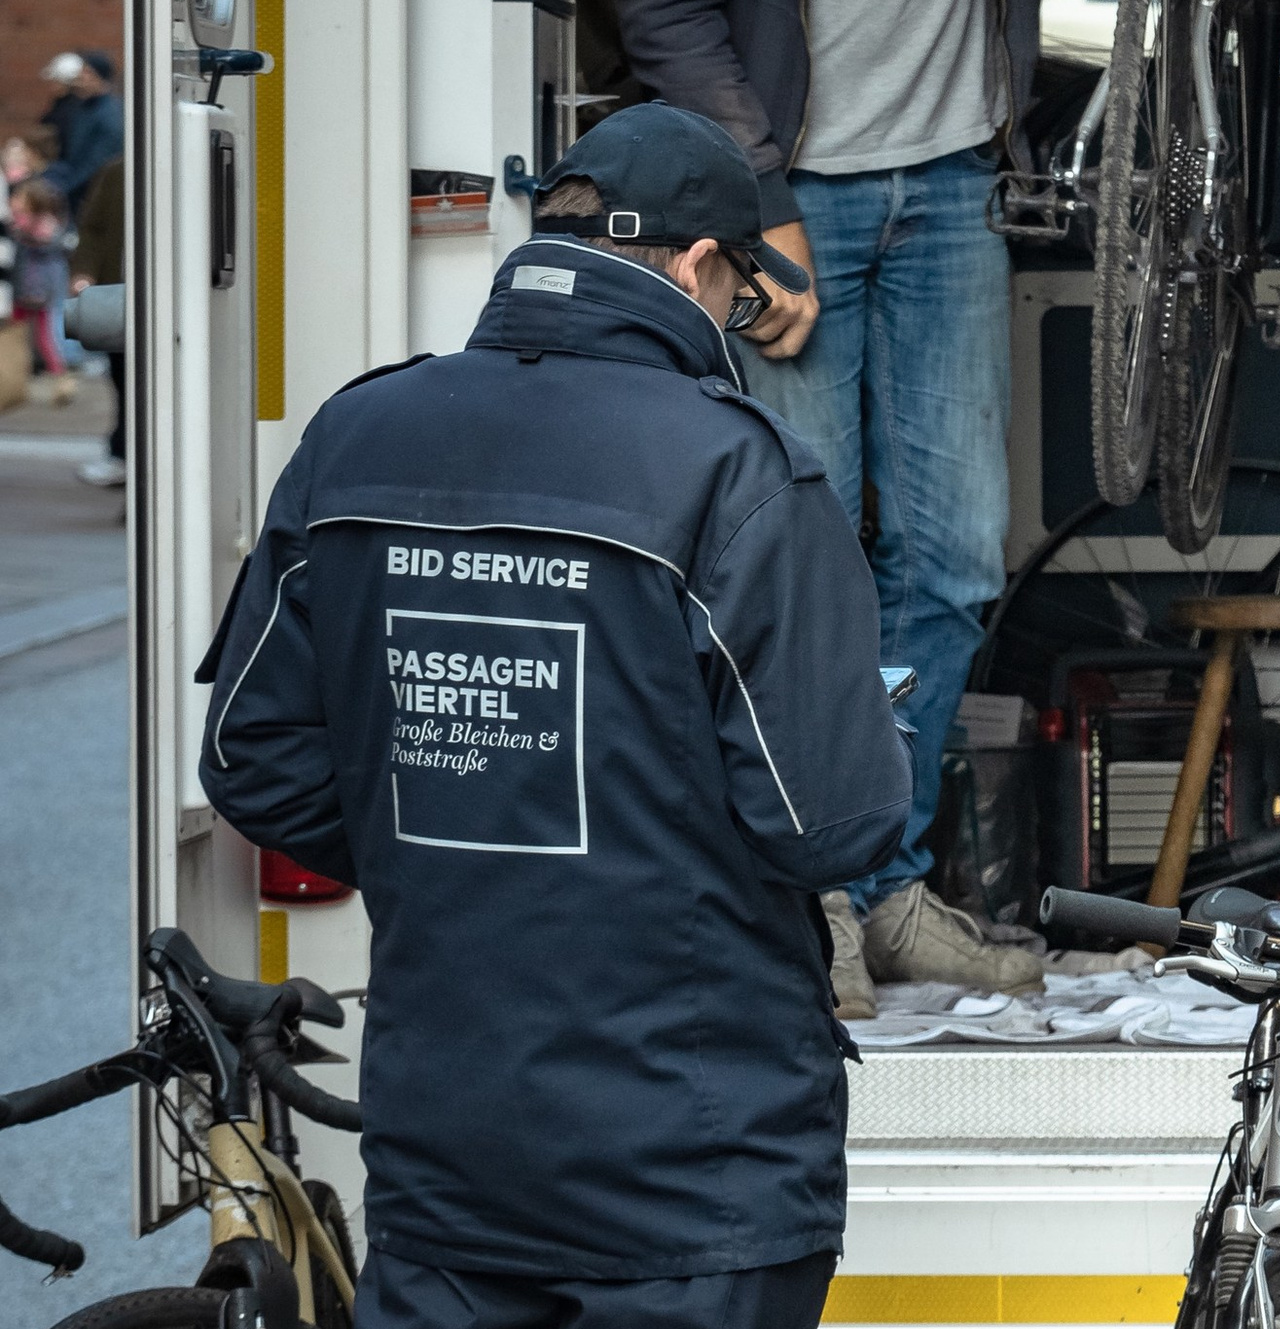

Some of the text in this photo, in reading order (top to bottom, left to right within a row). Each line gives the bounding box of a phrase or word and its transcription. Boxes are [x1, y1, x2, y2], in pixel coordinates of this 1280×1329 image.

[387, 546, 590, 589] BID SERVICE
[386, 647, 560, 690] PASSAGEN
[389, 680, 519, 720] VIERTEL
[393, 716, 560, 751] Große Bleichen &
[390, 742, 488, 776] Poststraße
